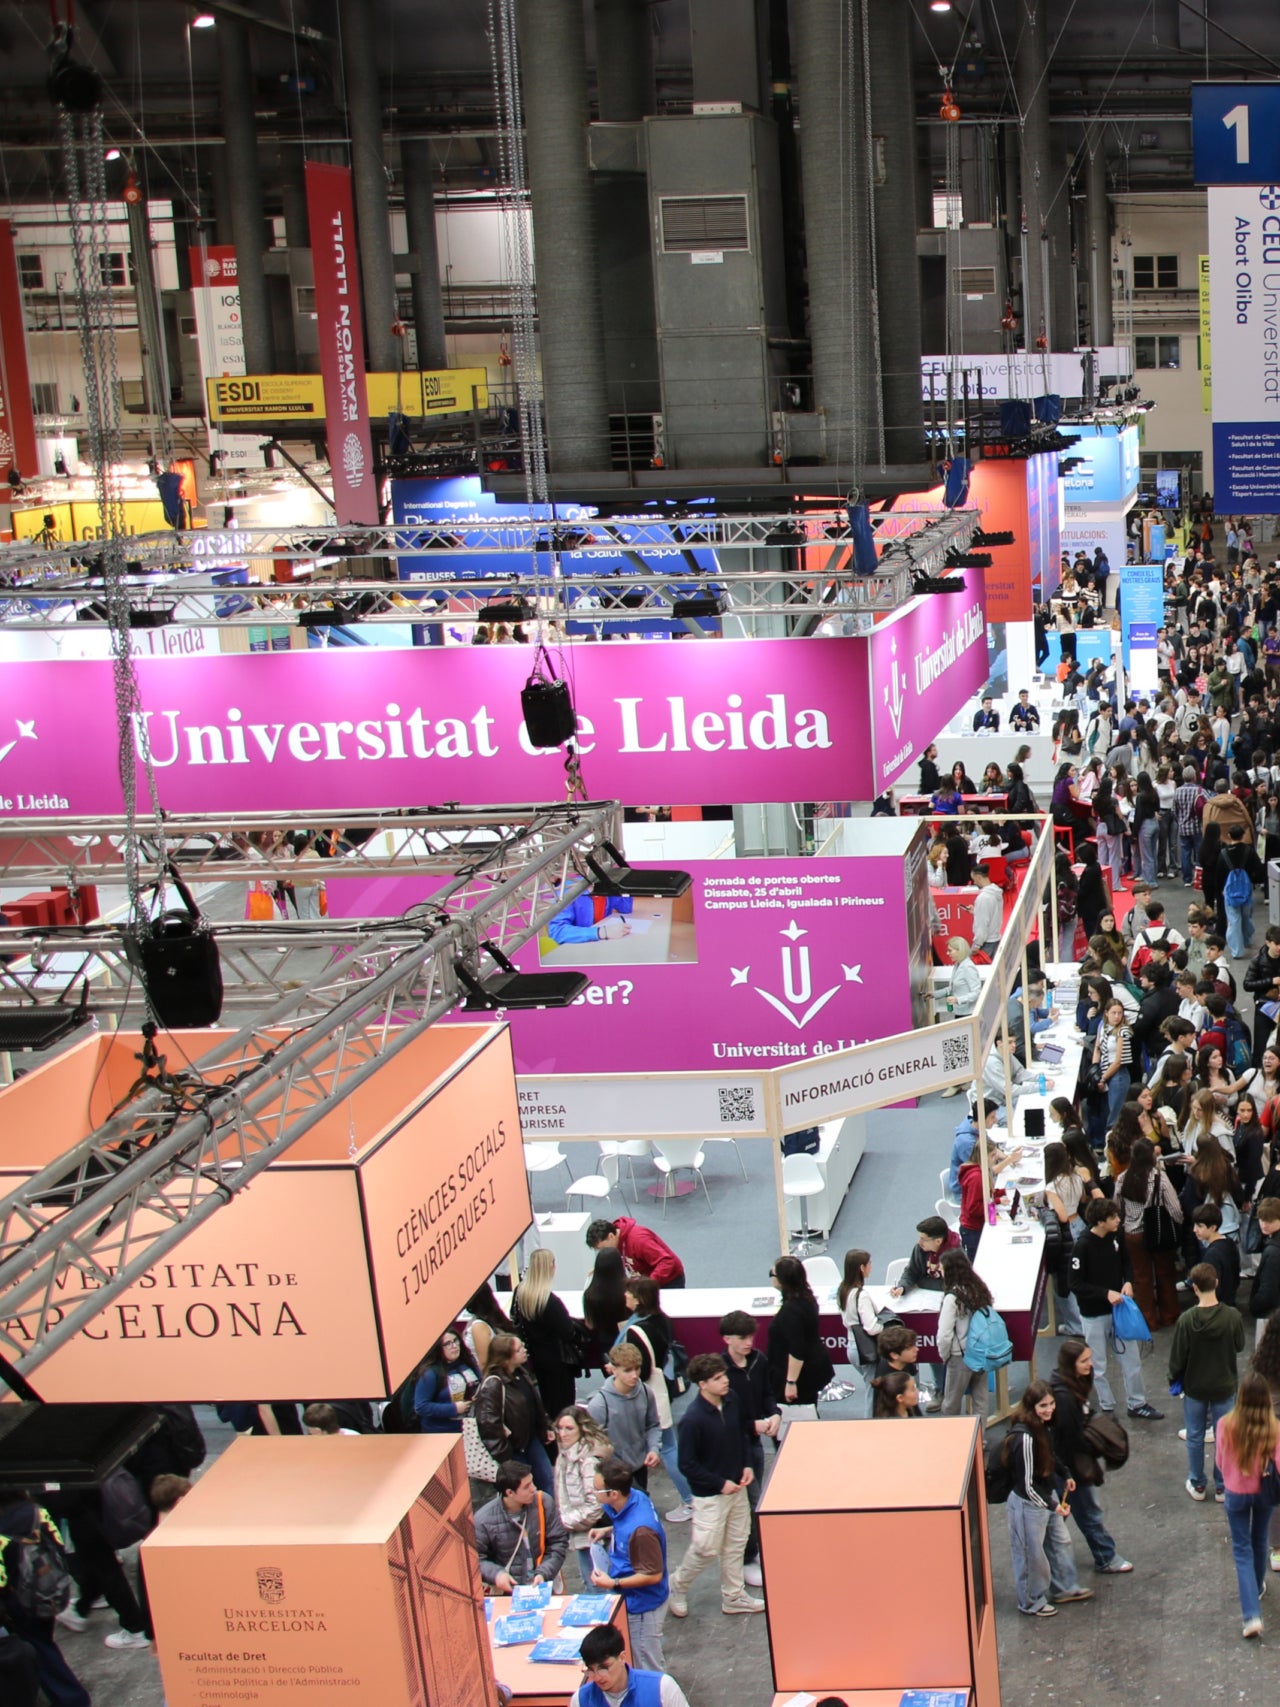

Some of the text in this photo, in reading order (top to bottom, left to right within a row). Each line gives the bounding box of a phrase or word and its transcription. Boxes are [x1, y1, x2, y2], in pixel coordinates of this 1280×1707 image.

[1222, 105, 1249, 164] 1
[1235, 216, 1252, 324] Abat Oliba
[332, 211, 358, 421] RAMON LLULL
[335, 321, 349, 422] UNIVERSITAT
[218, 381, 260, 402] ESDI
[914, 631, 956, 696] Universitat
[128, 702, 500, 768] Universitat
[614, 694, 834, 753] Lleida
[17, 794, 70, 810] Lleida
[704, 875, 841, 887] Jornada de portes obertes
[704, 886, 802, 898] Dissabte, 25 d'abril
[705, 897, 885, 911] Campus Lleida, Igualada i Pirineus
[712, 1040, 807, 1059] Universitat
[812, 1040, 833, 1056] de
[785, 1053, 938, 1107] INFORMACIÓ GENERAL
[396, 1120, 506, 1258] CIÈNCIES SOCIALS
[402, 1178, 496, 1305] I JURÍDIQUES I
[5, 1263, 299, 1292] VESITAT DE
[223, 1608, 314, 1619] UNIVERSITAT
[225, 1620, 328, 1632] BARCELONA
[178, 1652, 267, 1662] Facultat de Dret
[195, 1665, 260, 1674] Administració
[268, 1665, 306, 1674] Direcció
[309, 1664, 343, 1674] Pública
[197, 1678, 231, 1687] Ciència
[233, 1677, 269, 1687] Política
[276, 1677, 288, 1686] de
[199, 1690, 259, 1700] Criminologia
